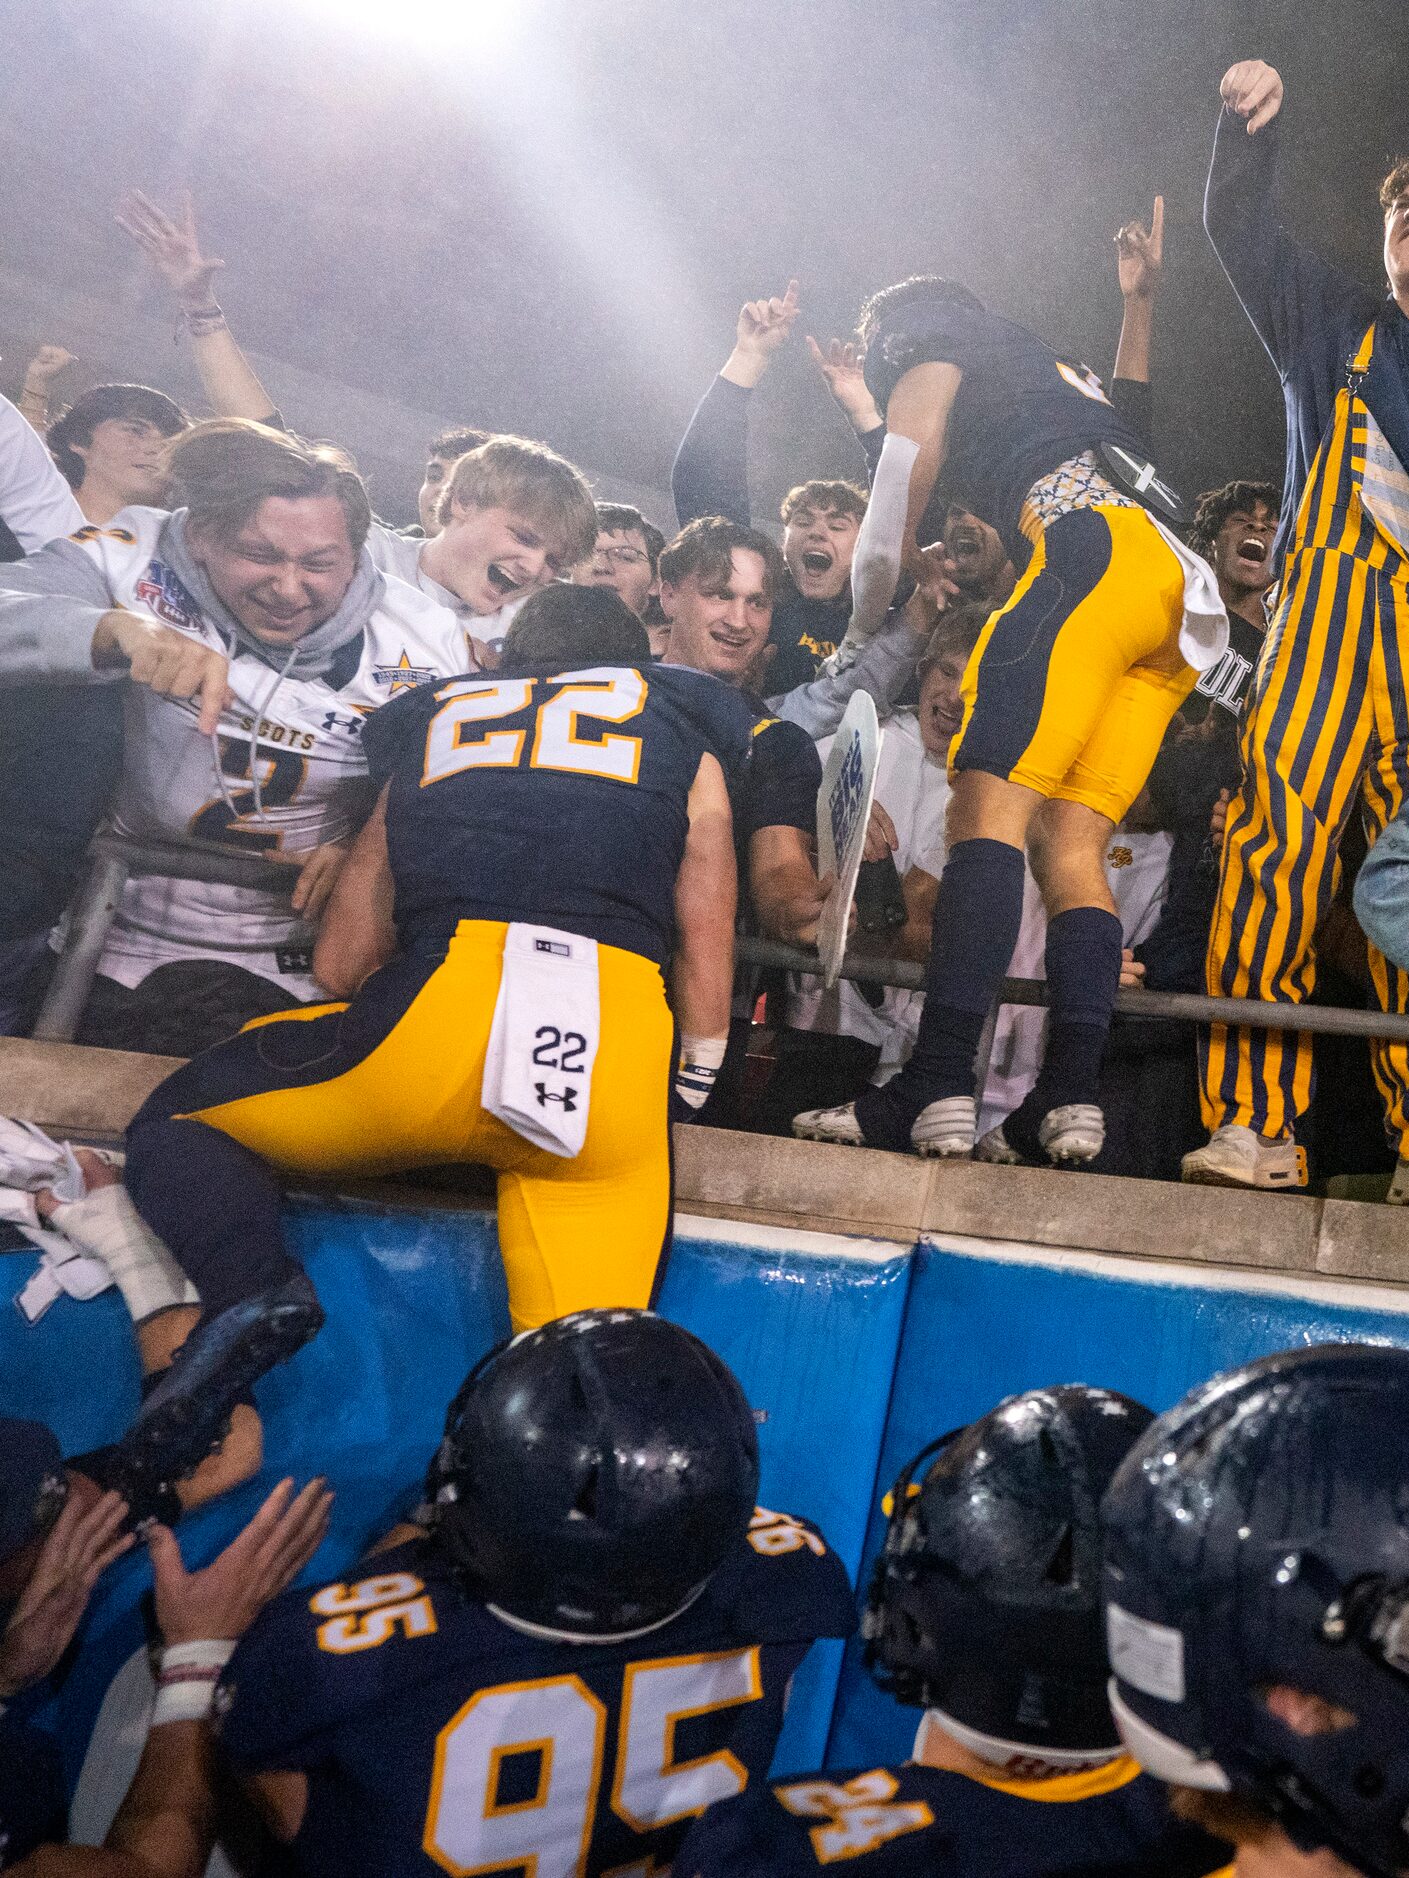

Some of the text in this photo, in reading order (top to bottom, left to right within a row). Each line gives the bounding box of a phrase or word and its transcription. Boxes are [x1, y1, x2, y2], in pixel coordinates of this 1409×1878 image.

[240, 716, 316, 750] SCOTS
[419, 667, 648, 788] 22
[532, 1026, 587, 1073] 22
[309, 1572, 438, 1655] 95
[422, 1645, 764, 1878] 95
